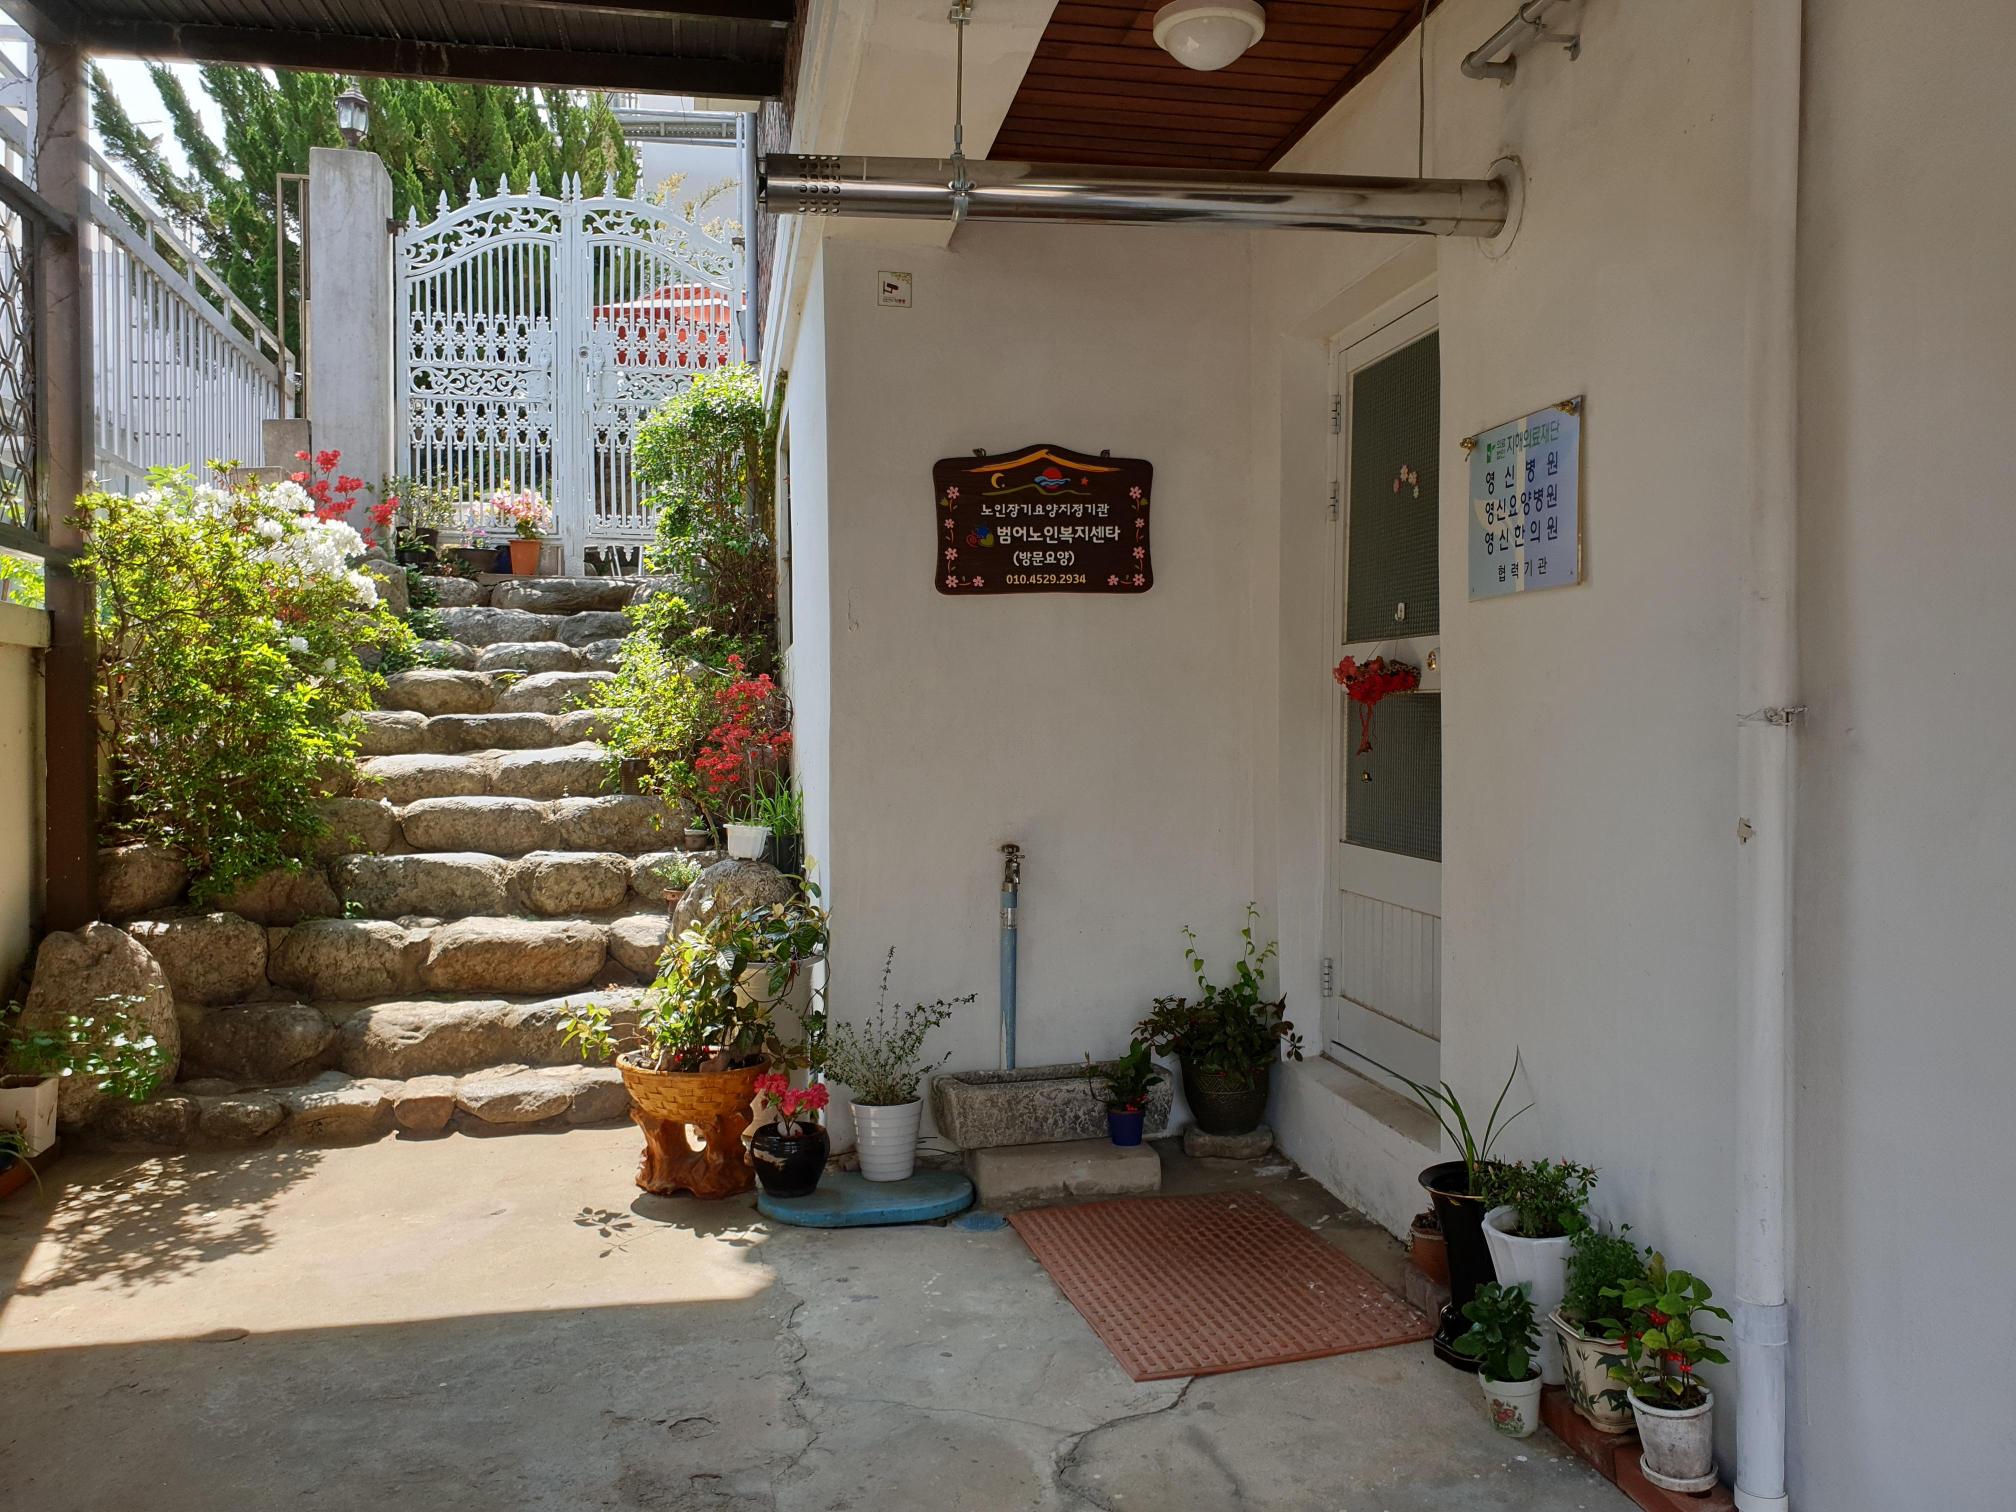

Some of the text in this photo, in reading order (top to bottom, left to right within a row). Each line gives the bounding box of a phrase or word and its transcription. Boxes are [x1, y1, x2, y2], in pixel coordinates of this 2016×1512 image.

[980, 503, 1110, 518] 노인장기요양지정기관
[1485, 483, 1558, 525] 영신요양병원
[997, 525, 1121, 544] 범어노인복지센타
[1484, 515, 1558, 556] 영신한의원
[1013, 550, 1075, 567] (방문요양)
[1006, 574, 1087, 585] 010.4529.2934
